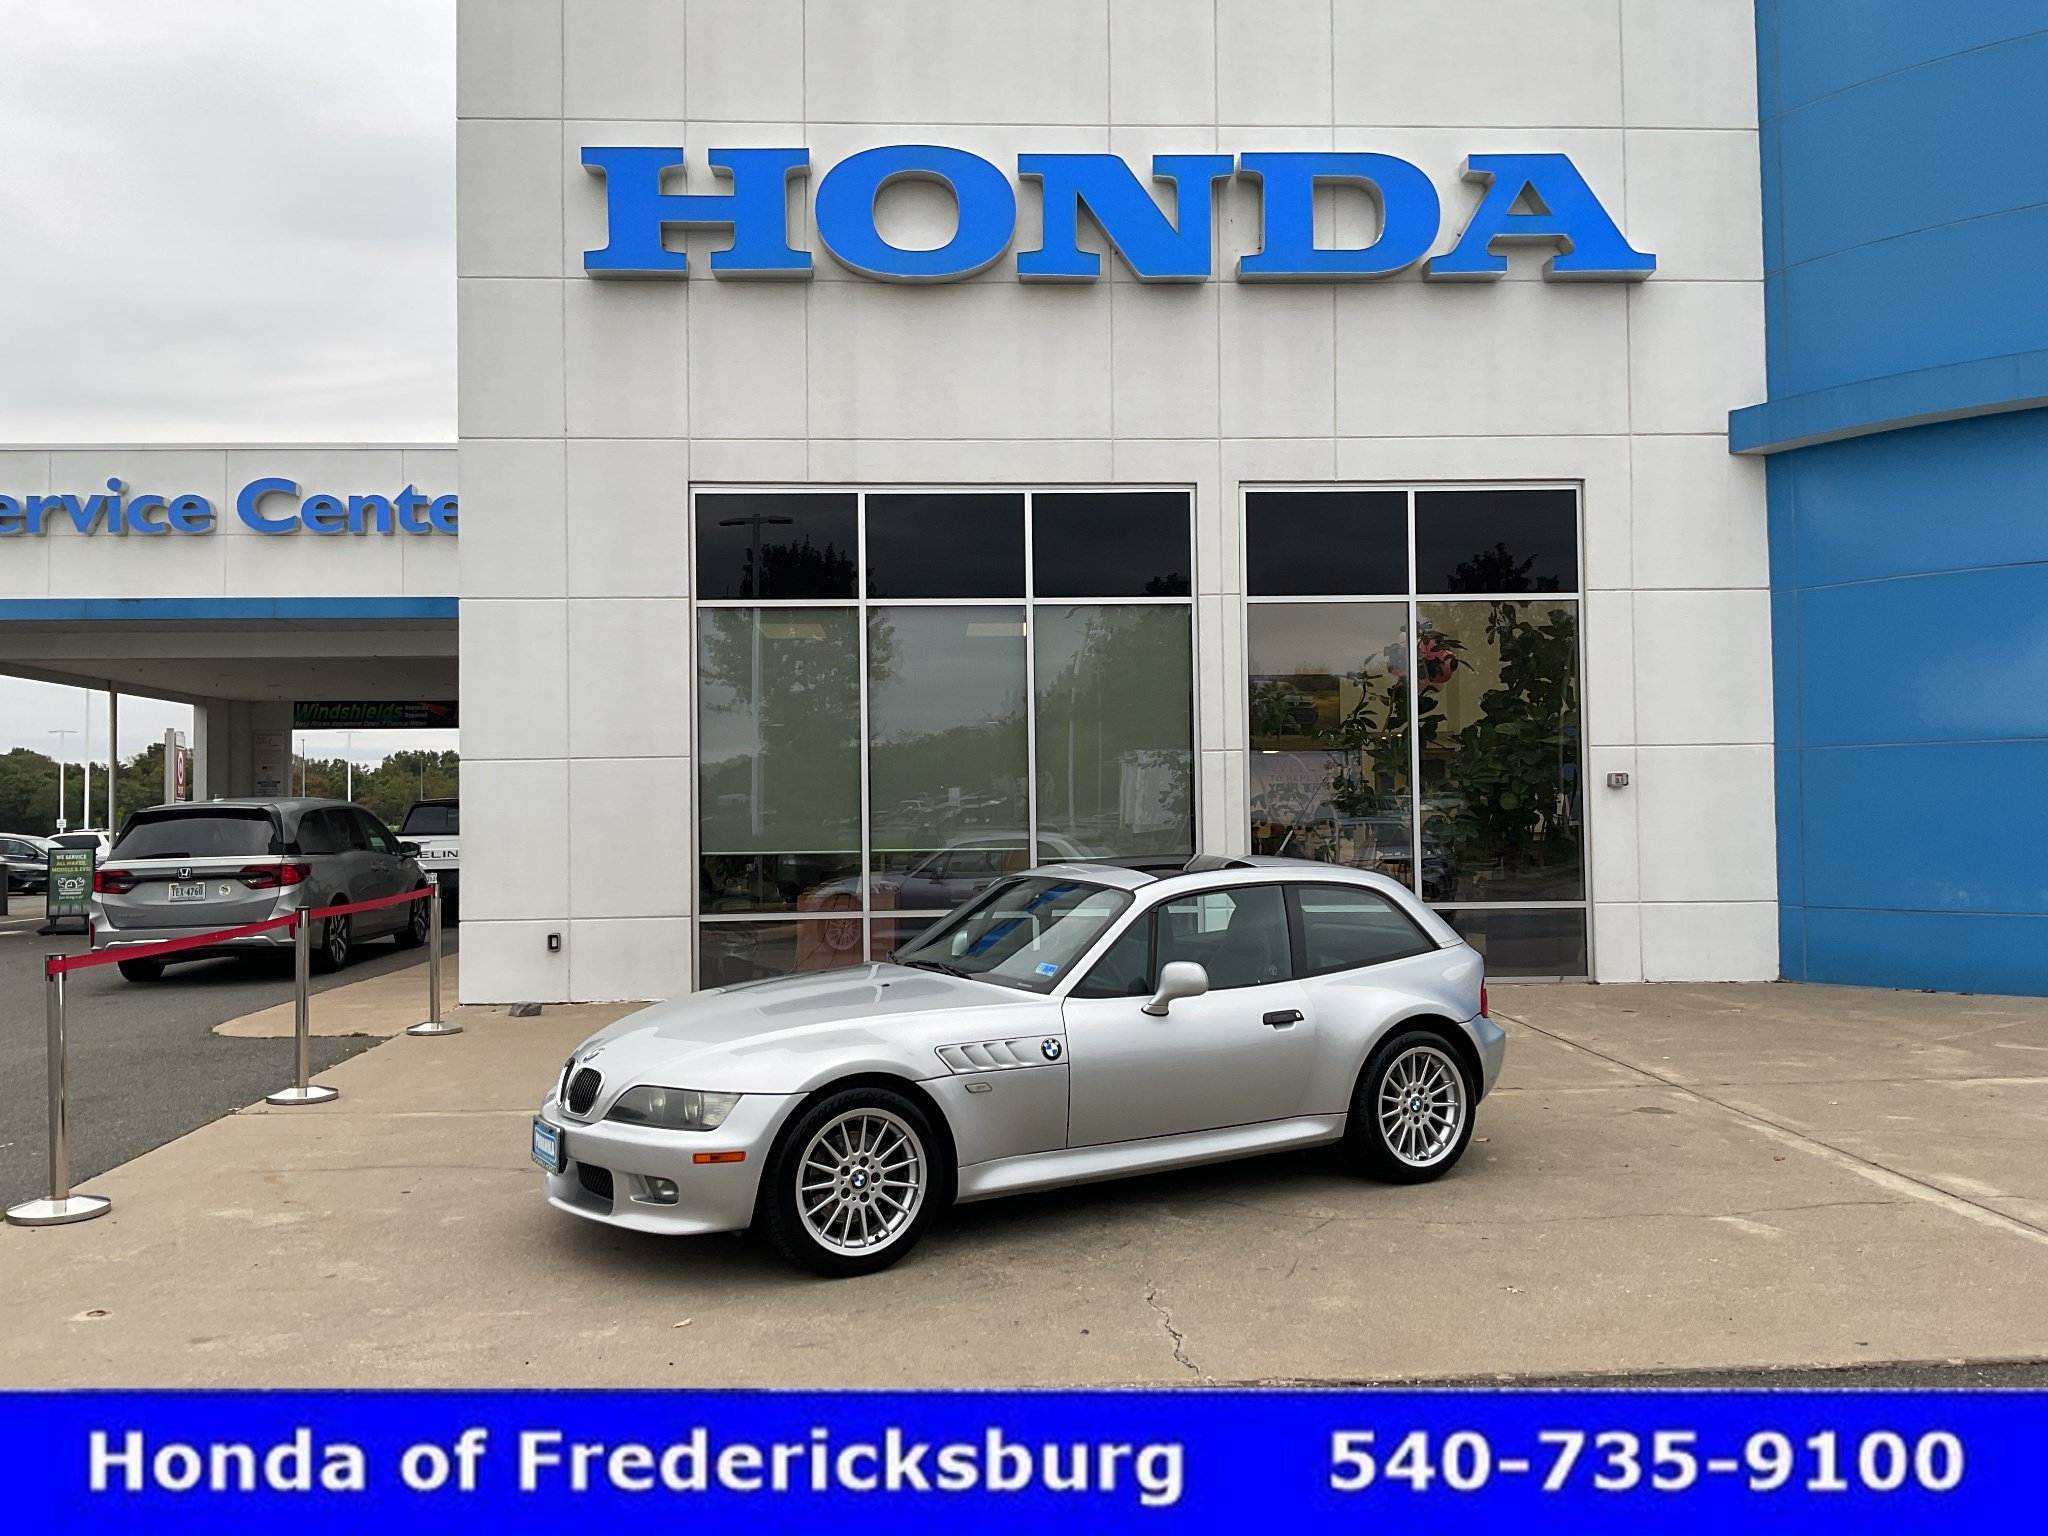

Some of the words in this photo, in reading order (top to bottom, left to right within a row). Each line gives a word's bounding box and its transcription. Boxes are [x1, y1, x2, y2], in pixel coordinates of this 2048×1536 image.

[581, 145, 1656, 279] HONDA
[238, 478, 458, 533] Cente
[295, 703, 402, 720] Windshields
